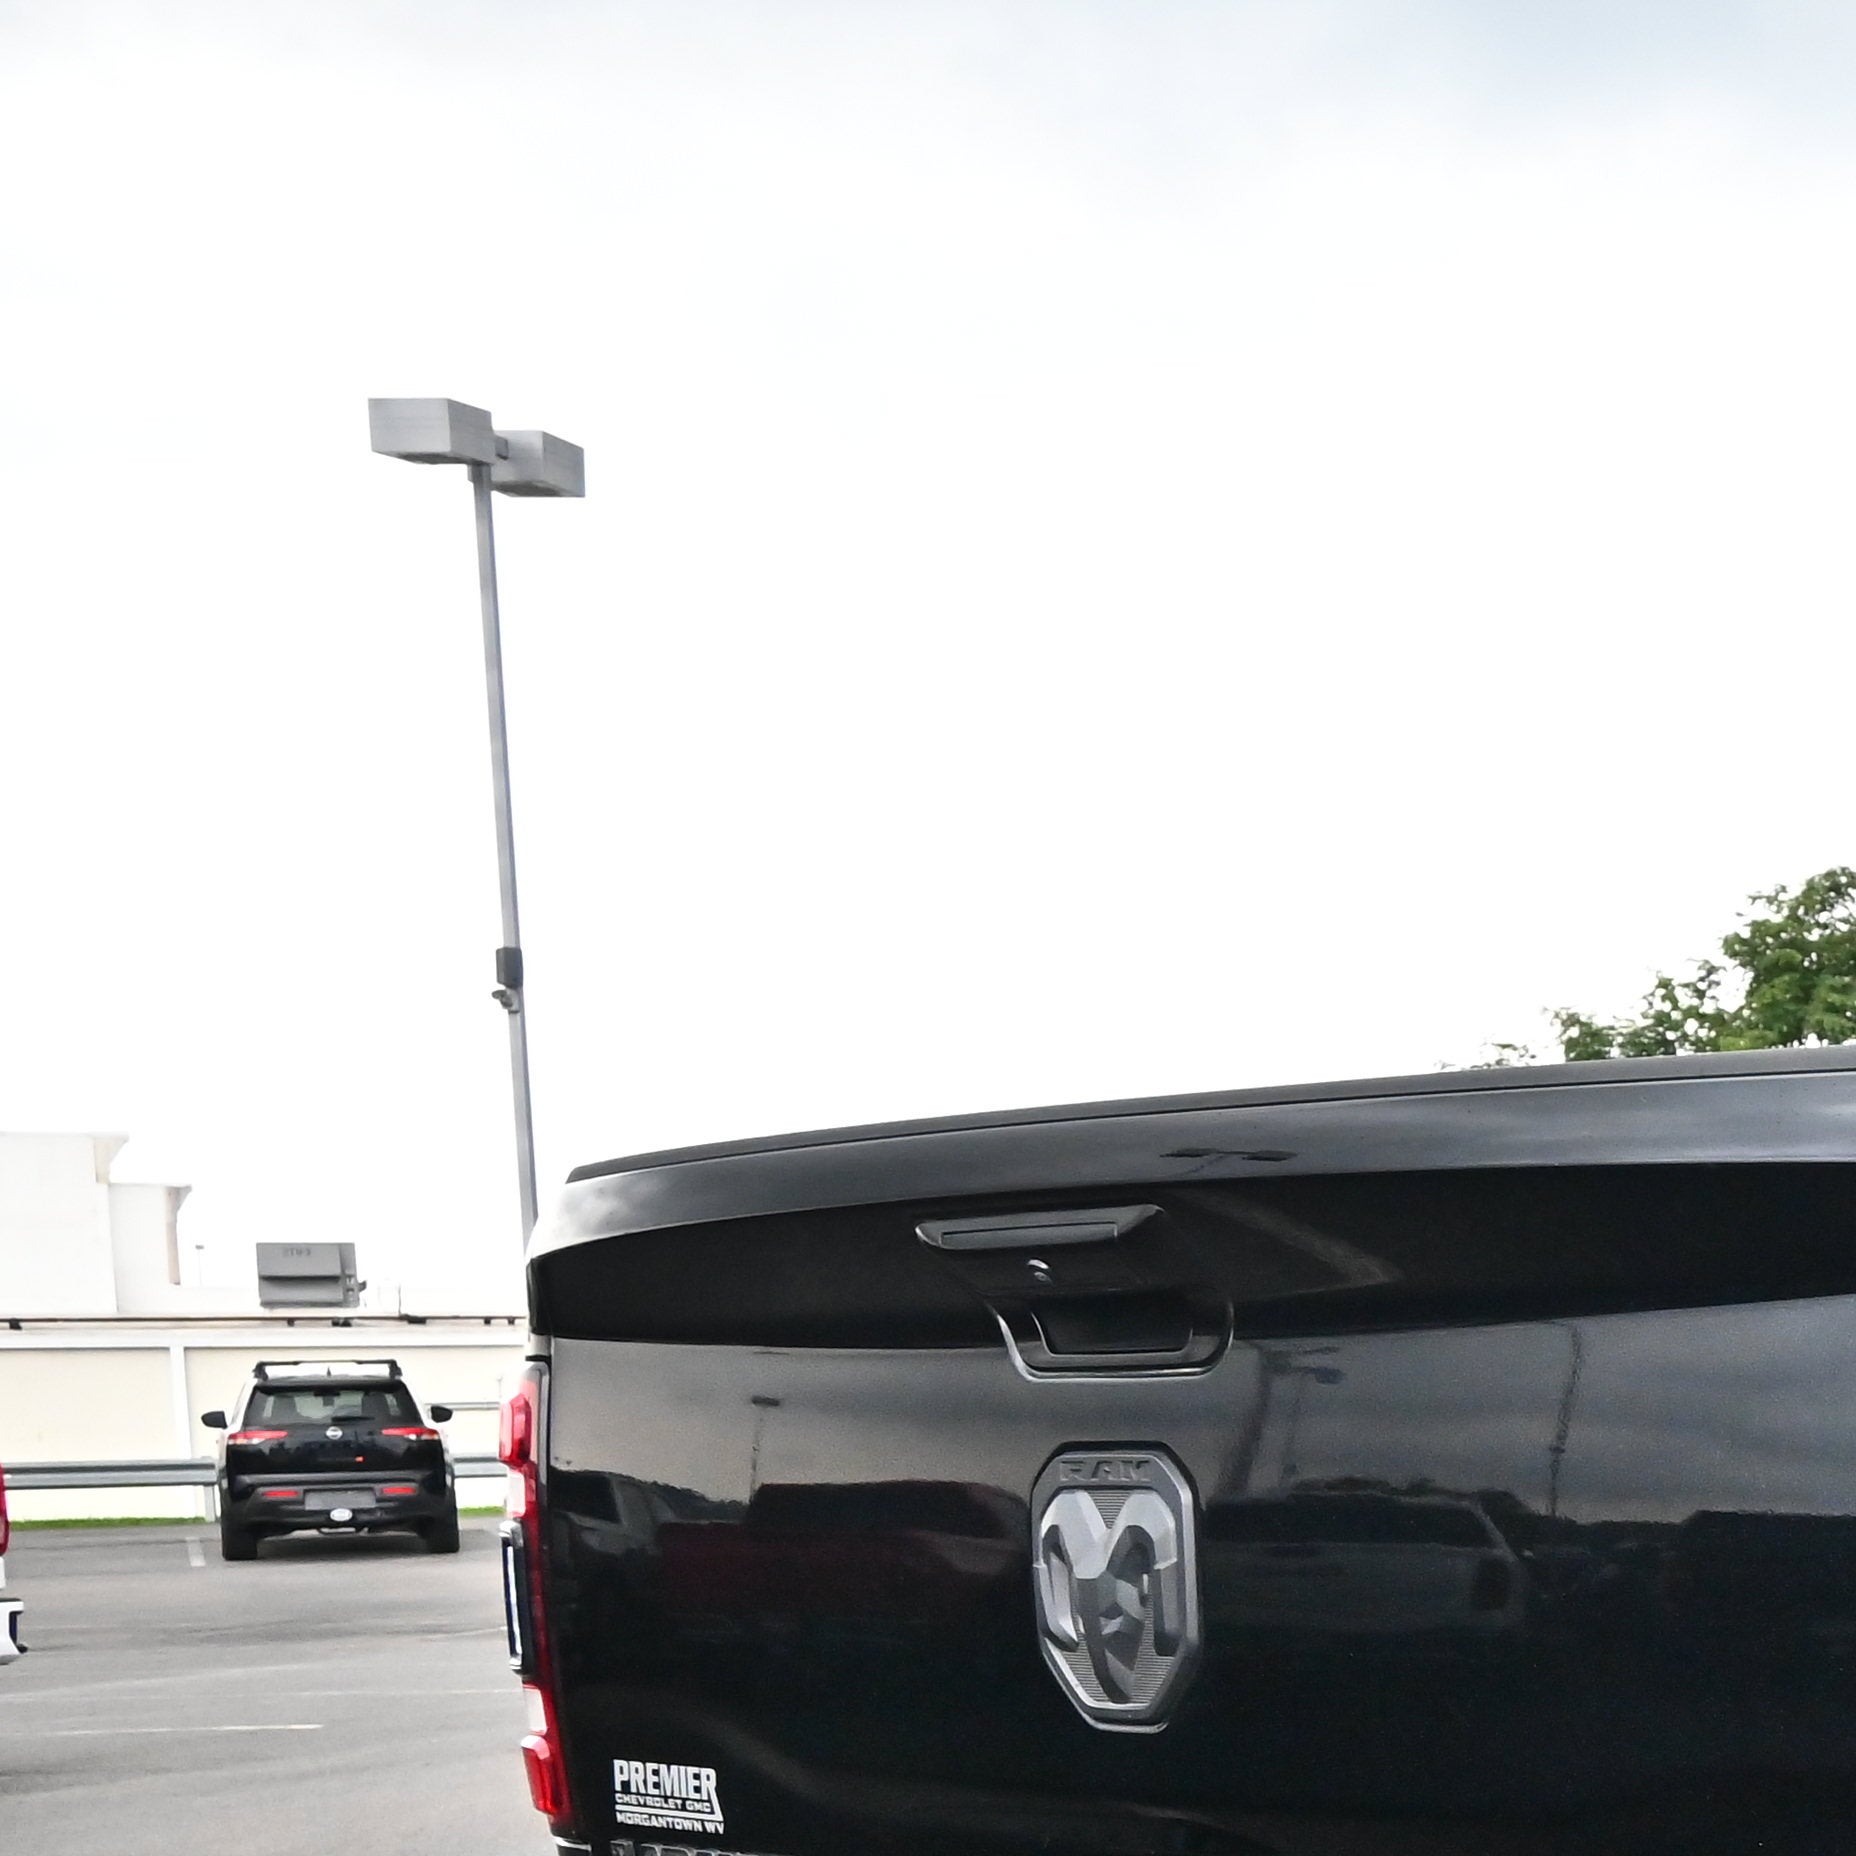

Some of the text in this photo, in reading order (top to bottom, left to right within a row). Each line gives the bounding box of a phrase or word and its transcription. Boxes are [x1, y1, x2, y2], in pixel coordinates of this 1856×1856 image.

[1059, 1459, 1152, 1482] RAM
[612, 1758, 720, 1803] PREMIER
[614, 1793, 711, 1812] CHEVROLET GMC
[615, 1811, 725, 1835] MORGANTOWN WV
